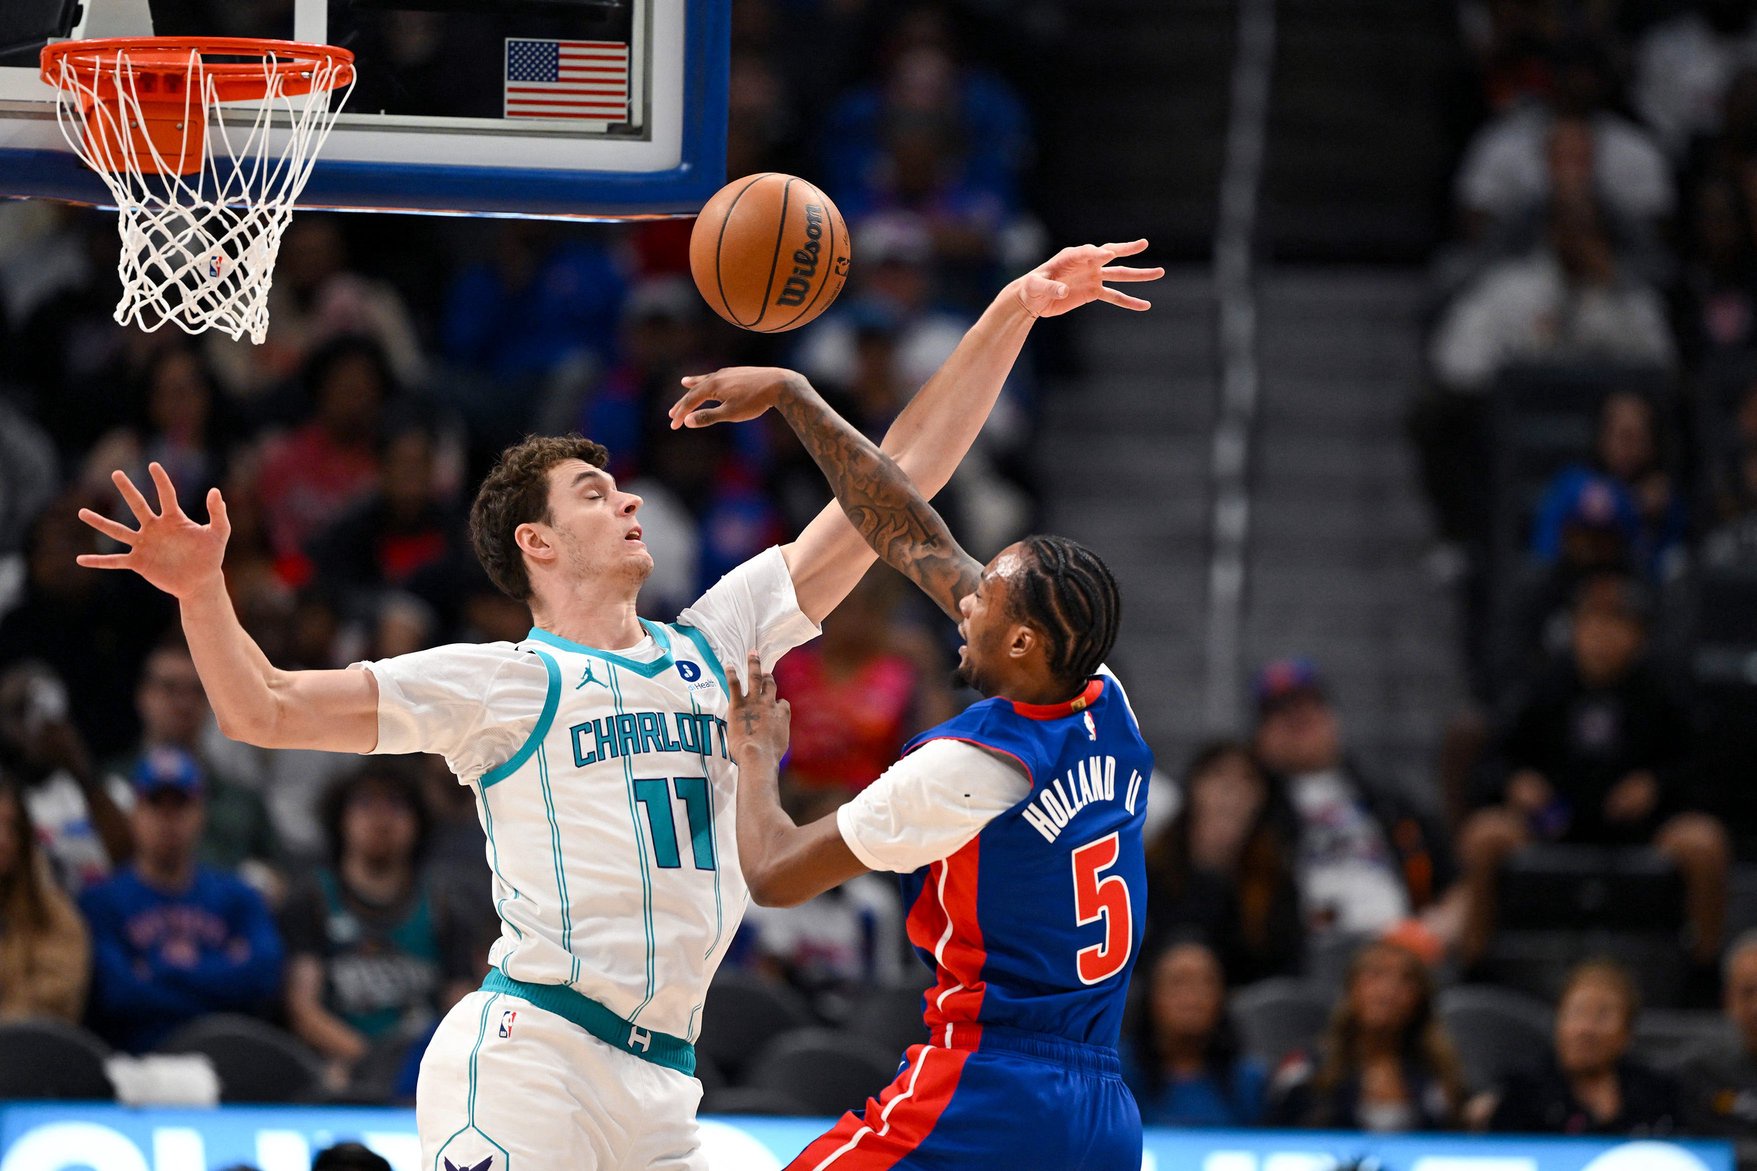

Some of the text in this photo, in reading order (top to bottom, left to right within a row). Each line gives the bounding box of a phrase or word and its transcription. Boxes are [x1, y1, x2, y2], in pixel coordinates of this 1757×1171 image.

[775, 204, 822, 307] Wilson
[569, 712, 737, 768] CHARLOTT
[633, 777, 716, 871] 11
[1022, 755, 1116, 844] HOLLAND
[1071, 830, 1133, 985] 5
